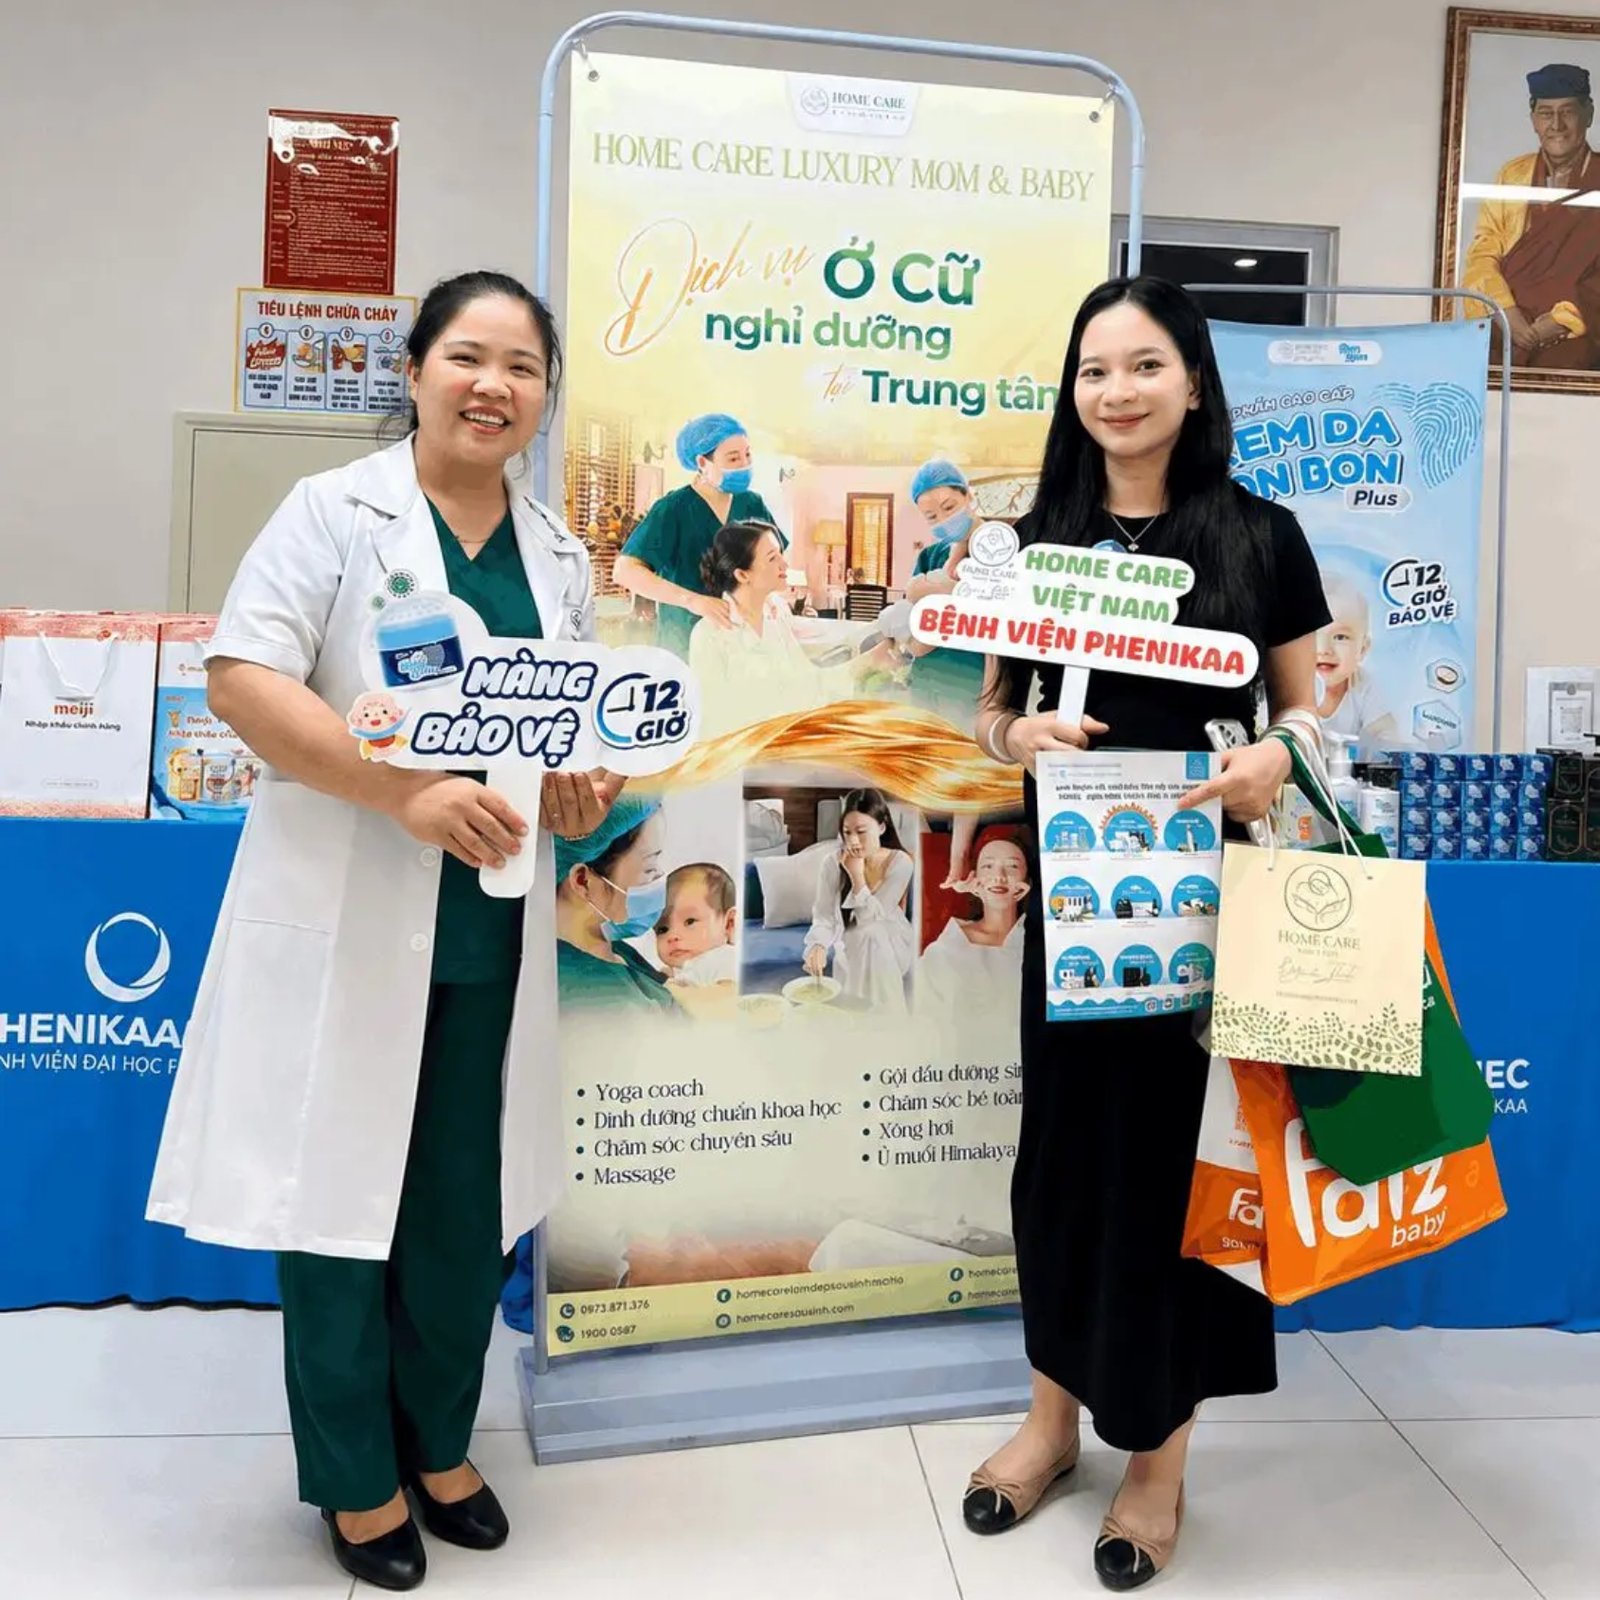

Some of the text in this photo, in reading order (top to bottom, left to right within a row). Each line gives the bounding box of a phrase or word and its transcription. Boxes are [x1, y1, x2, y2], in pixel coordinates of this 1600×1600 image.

[832, 92, 905, 109] HOME CARE
[593, 132, 1095, 201] HOME CARE LUXURY MOM & BABY
[824, 236, 875, 299] Ở
[892, 252, 980, 305] Cữ
[705, 305, 951, 360] nghỉ dưỡng
[862, 370, 986, 416] Trung
[1280, 391, 1316, 409] CAO
[1230, 406, 1400, 467] EM DA
[1297, 451, 1402, 493] BON
[1353, 490, 1398, 507] Plus
[1025, 550, 1190, 590] HOME CARE
[1414, 564, 1441, 587] 12
[1032, 584, 1096, 615] VIỆT
[1100, 595, 1170, 623] NAM
[919, 605, 1245, 675] BỆNH VIỆN PHENIKAA
[462, 648, 598, 701] MÀNG
[54, 702, 93, 718] meiji
[643, 679, 681, 713] 12
[411, 701, 580, 767] BẢO VỆ
[1278, 930, 1361, 950] HOME CARE
[83, 1053, 116, 1074] ĐẠI
[123, 1056, 162, 1077] HỌC
[1476, 1059, 1530, 1089] EC
[596, 1078, 704, 1103] Yoga coach
[595, 1109, 634, 1129] Dinh
[761, 1101, 804, 1119] khoa
[809, 1099, 842, 1119] học
[652, 1136, 685, 1153] sóc
[941, 1142, 1016, 1162] Himalaya
[594, 1166, 676, 1185] Massage
[1391, 1207, 1446, 1248] baby
[581, 1327, 607, 1338] 1900
